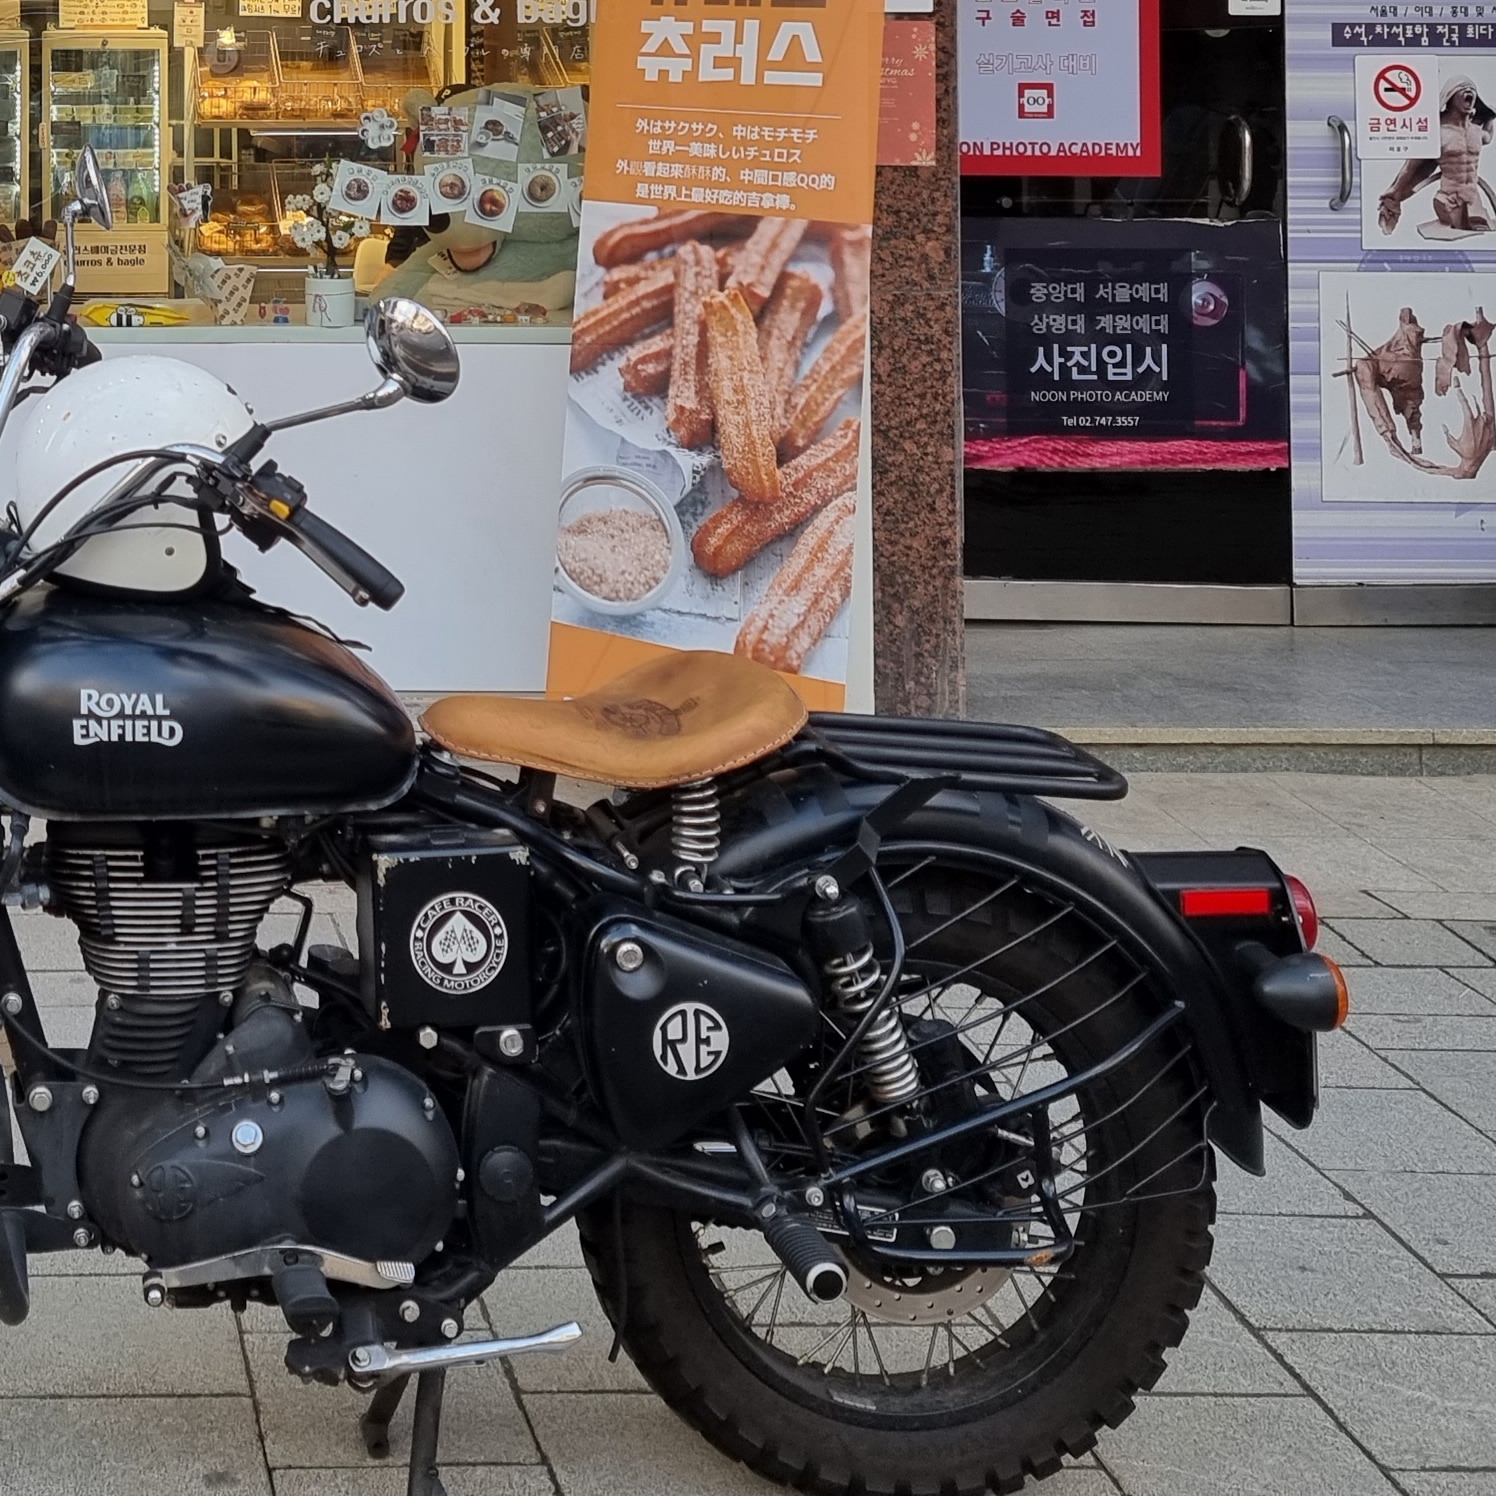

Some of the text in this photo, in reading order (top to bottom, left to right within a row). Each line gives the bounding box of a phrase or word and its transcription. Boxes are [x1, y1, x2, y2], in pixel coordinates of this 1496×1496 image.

[1369, 6, 1398, 17] 서울대
[637, 16, 824, 87] 츄러스
[976, 53, 1098, 75] 실기고사 대비
[1368, 117, 1429, 133] 금연시설
[989, 141, 1052, 156] PHOTO
[1056, 141, 1141, 156] ACADEMY
[116, 257, 145, 268] bagle
[1029, 282, 1169, 303] 중앙대 서울예대
[1030, 313, 1169, 334] 상명대 계원예대
[1029, 343, 1169, 381] 사진입시
[1030, 390, 1170, 402] NOON PHOTO ACADEMY
[1061, 415, 1140, 427] Tel 02.747.3557
[80, 688, 171, 718] ROYAL
[72, 718, 184, 747] ENFIELD
[420, 896, 499, 928] CAFE RACER
[413, 938, 505, 991] RACING MOTORCYCLE
[659, 1007, 726, 1077] RE
